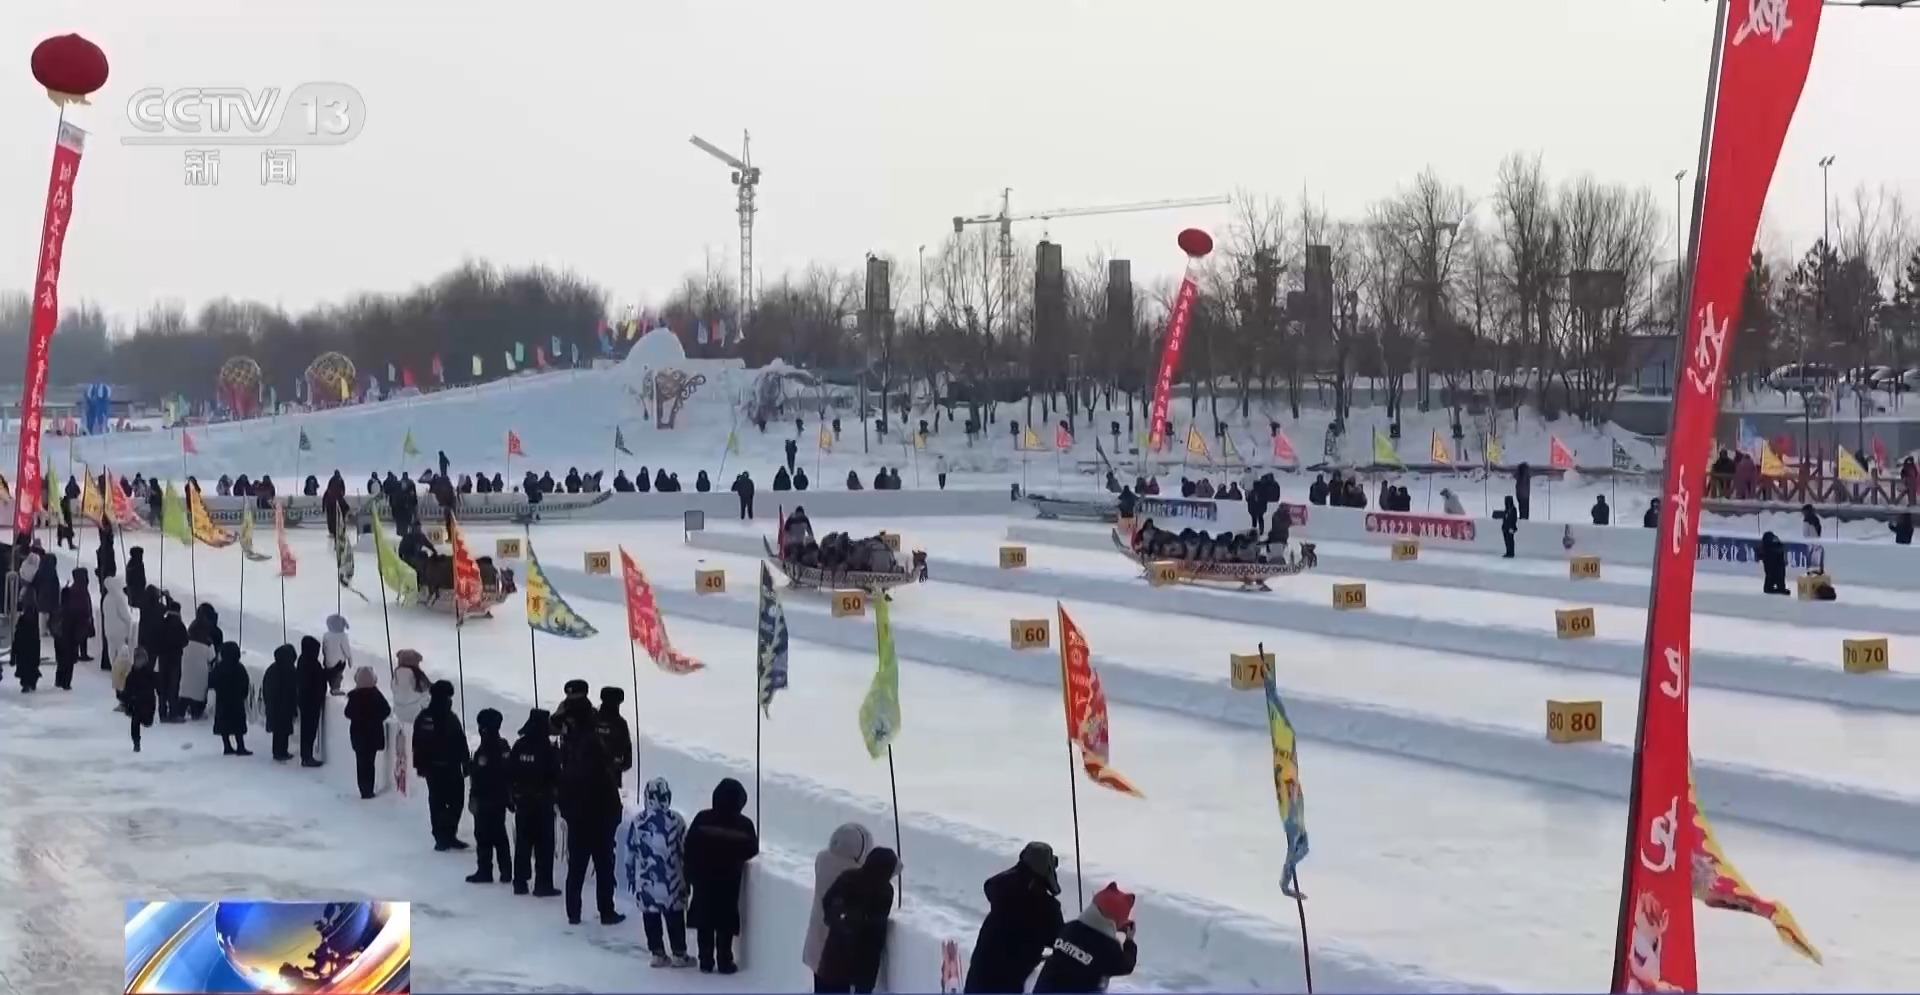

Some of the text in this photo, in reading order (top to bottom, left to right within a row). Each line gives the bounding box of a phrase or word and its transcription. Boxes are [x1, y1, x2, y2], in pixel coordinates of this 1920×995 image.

[503, 543, 518, 554] 20
[591, 557, 607, 569] 30
[705, 576, 722, 588] 40
[1160, 569, 1175, 581] 40
[1571, 616, 1590, 631] 60
[1025, 628, 1045, 642] 60
[1846, 648, 1857, 664] 70
[1864, 647, 1884, 663] 70
[1232, 663, 1242, 681] 70
[1549, 711, 1563, 731] 80
[1571, 712, 1596, 732] 80
